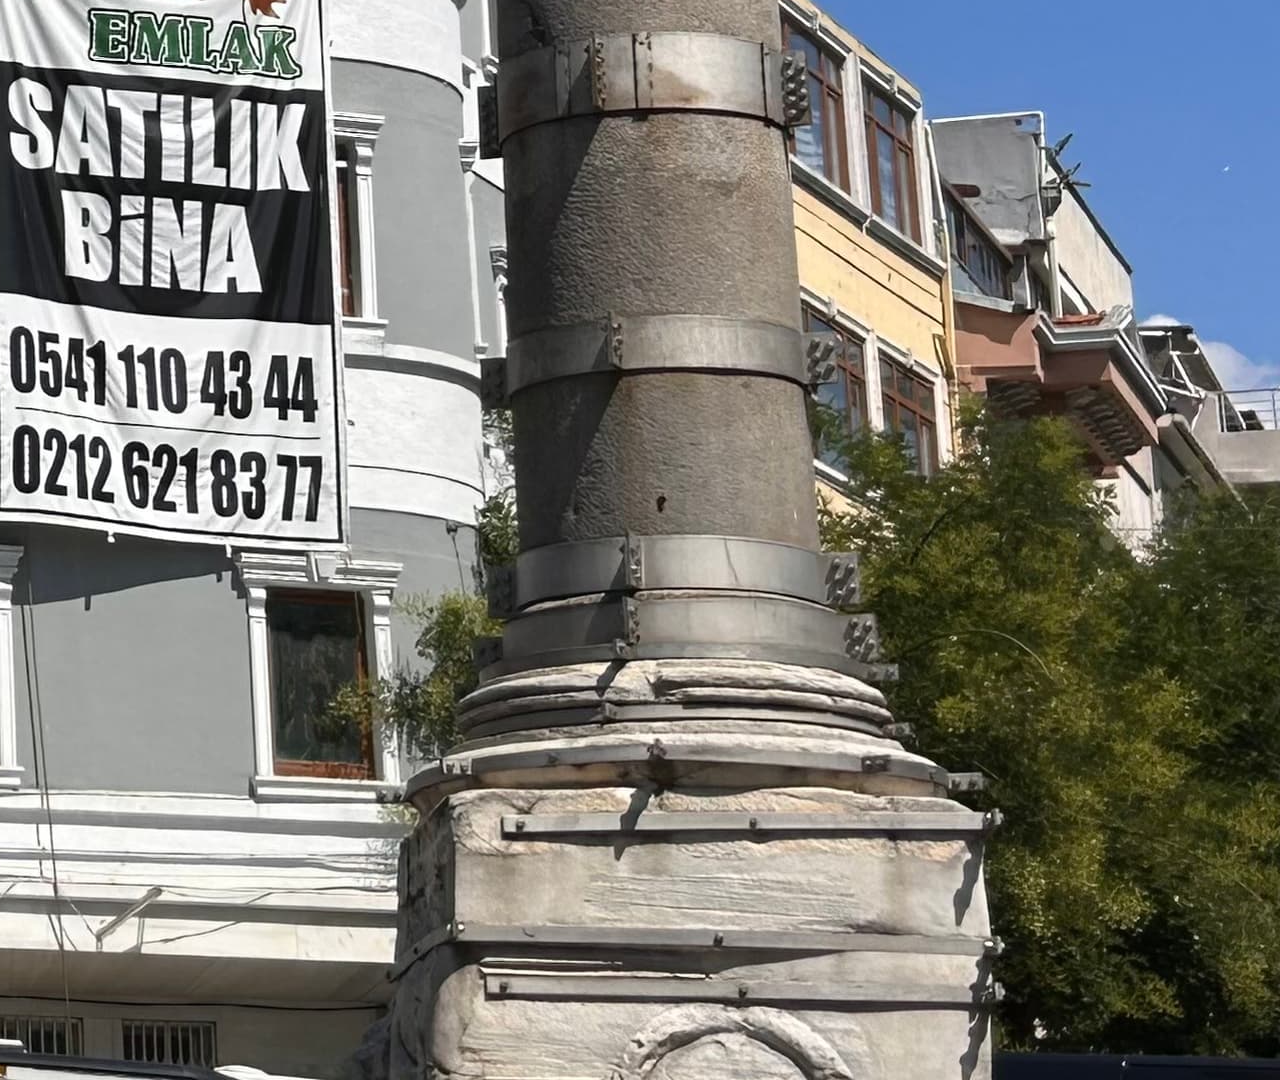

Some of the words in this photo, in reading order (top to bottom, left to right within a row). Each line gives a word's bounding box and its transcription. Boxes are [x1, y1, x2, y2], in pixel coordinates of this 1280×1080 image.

[89, 8, 303, 79] EMLAK
[8, 77, 311, 192] SATILIK
[9, 325, 107, 407] 0541
[117, 344, 187, 413] 110
[200, 350, 253, 419] 43
[263, 355, 319, 423] 44
[12, 425, 115, 502] 0212
[121, 441, 199, 513] 621
[211, 449, 267, 520] 83
[277, 454, 323, 522] 77
